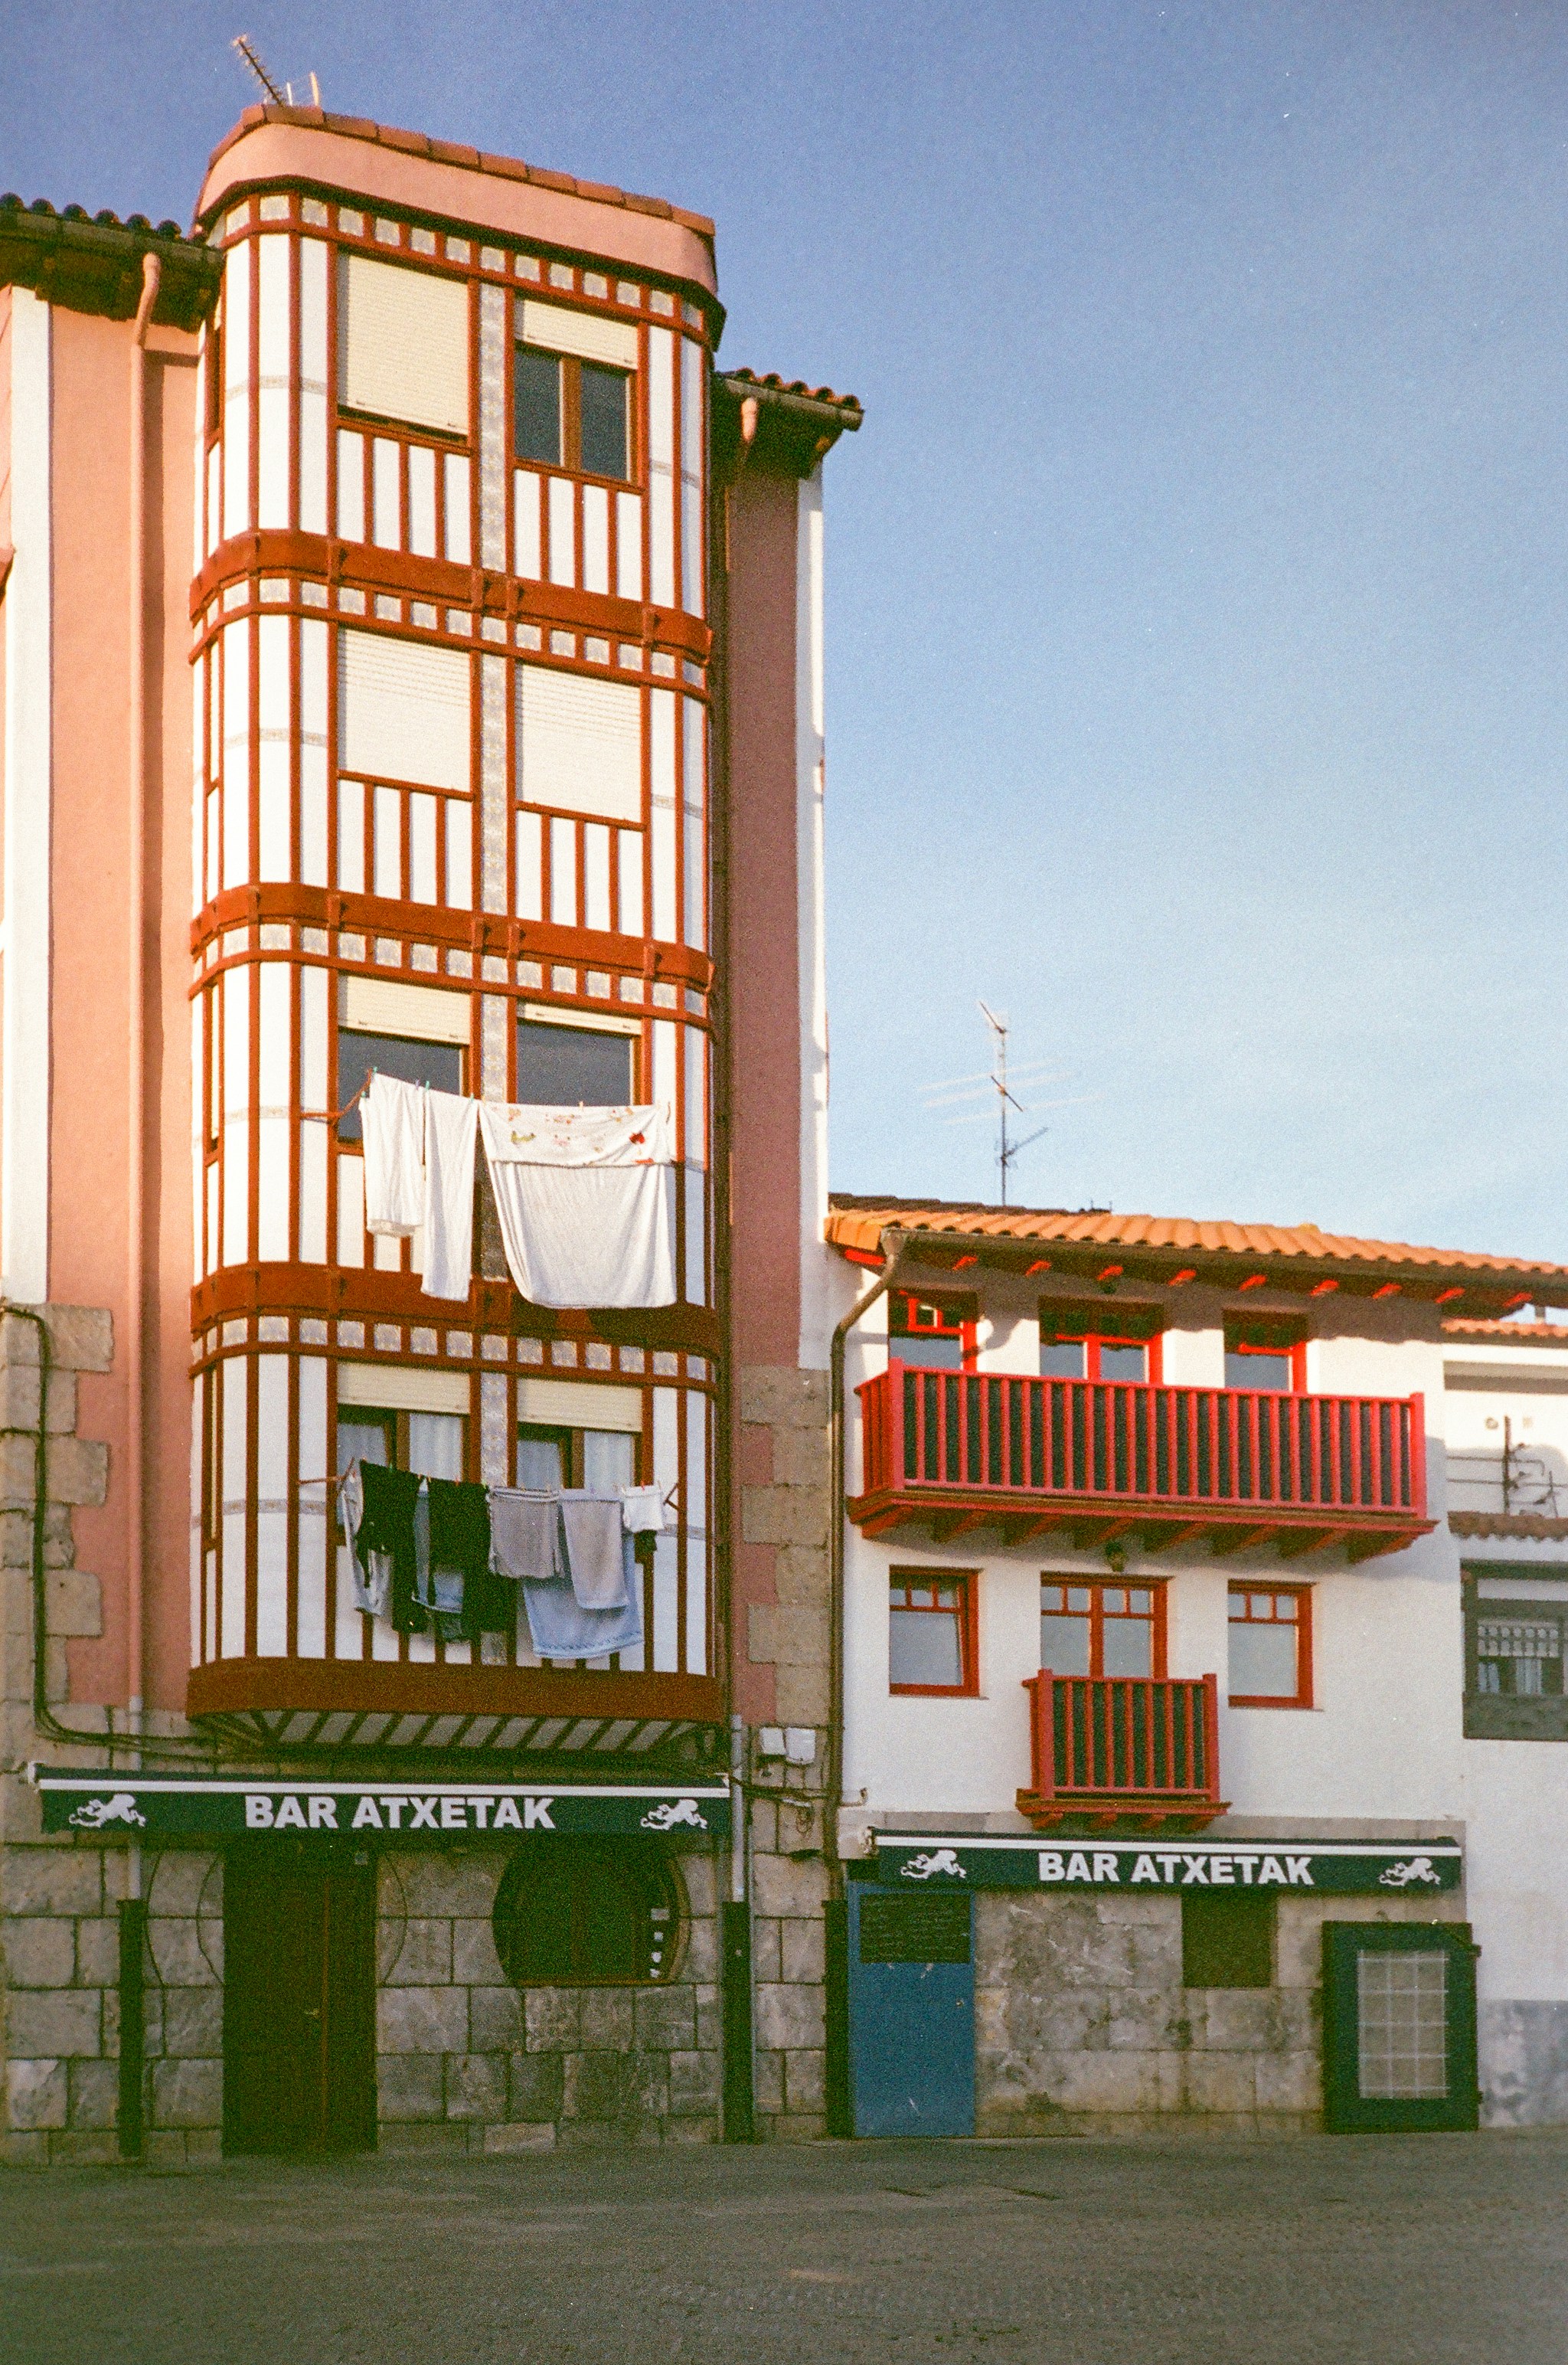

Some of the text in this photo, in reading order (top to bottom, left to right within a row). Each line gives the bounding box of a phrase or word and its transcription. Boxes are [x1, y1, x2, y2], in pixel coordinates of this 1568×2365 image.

[244, 1795, 557, 1829] BAR ATXETAK
[1037, 1851, 1315, 1886] BAR ATXETAK
